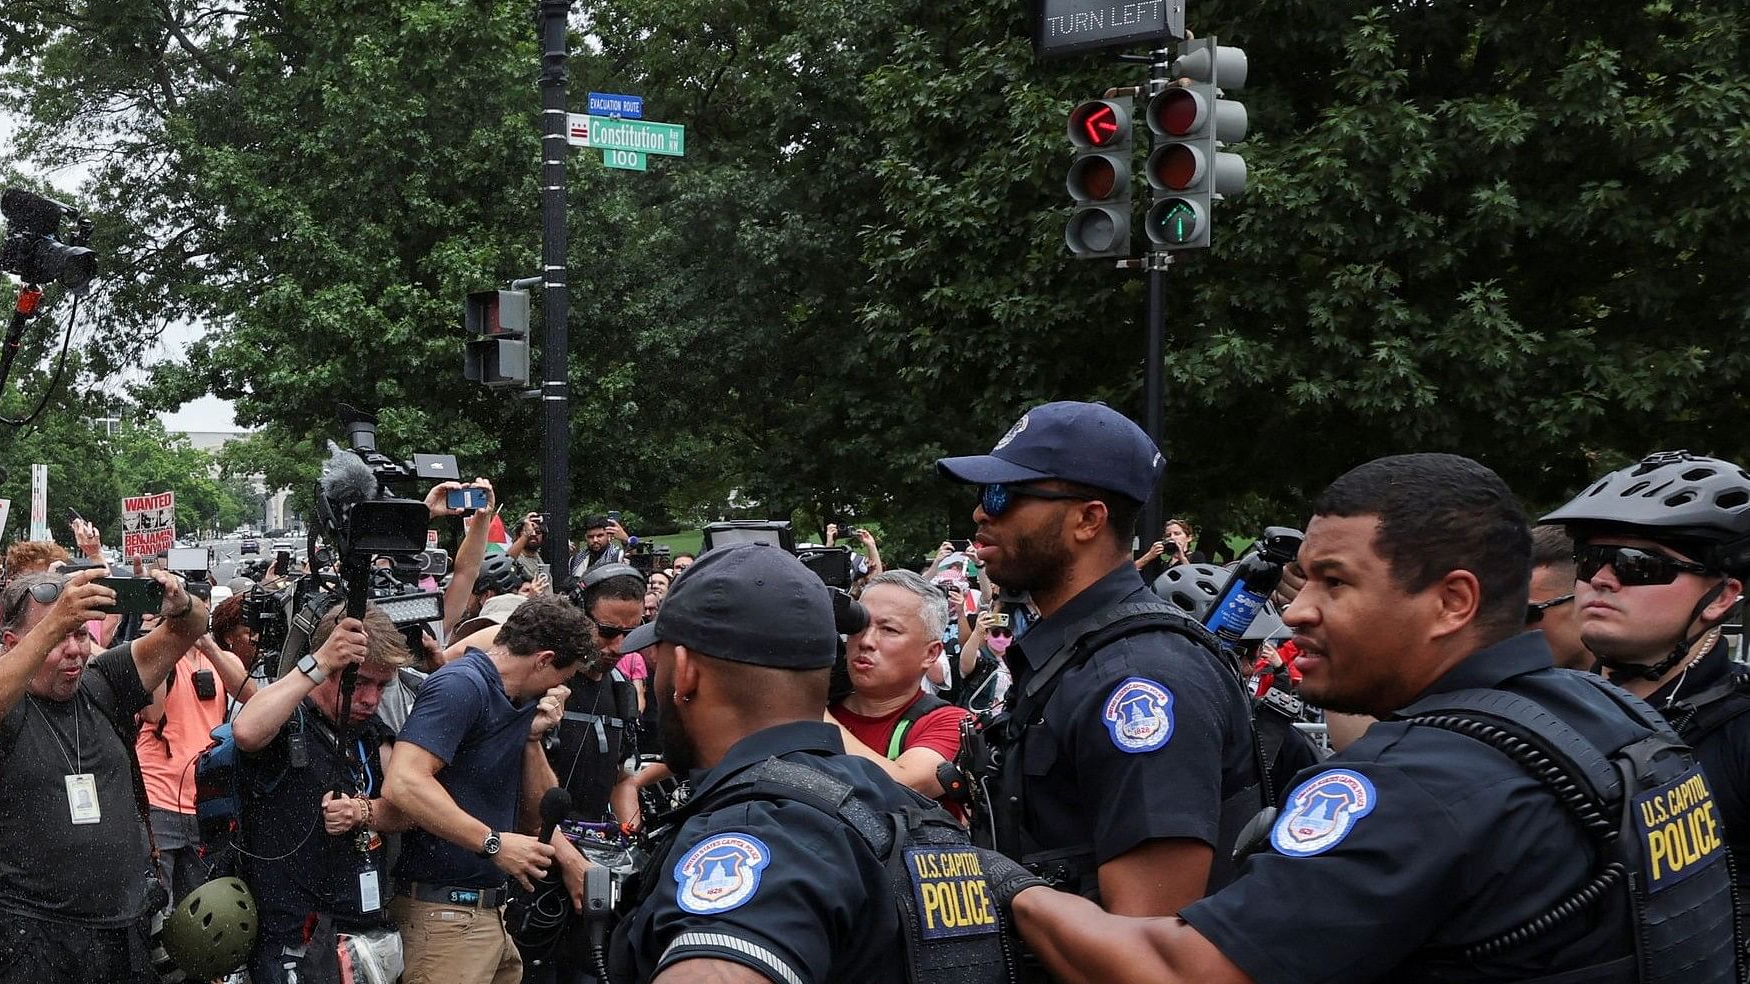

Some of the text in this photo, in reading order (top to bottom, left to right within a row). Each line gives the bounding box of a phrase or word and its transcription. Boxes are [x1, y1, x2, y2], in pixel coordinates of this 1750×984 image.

[1047, 0, 1163, 36] TURN LEFT
[590, 98, 640, 113] EVACUATION ROUTE
[592, 121, 664, 150] Constitution
[669, 140, 679, 152] NW
[612, 150, 638, 167] 100
[125, 493, 172, 512] WANTED
[125, 530, 173, 547] BENJAMIN
[1640, 773, 1710, 828] U.S. CAPITOL
[1648, 800, 1721, 881] POLICE
[914, 853, 942, 878] U.S.
[940, 853, 983, 877] CAPITOL
[921, 880, 995, 929] POLICE
